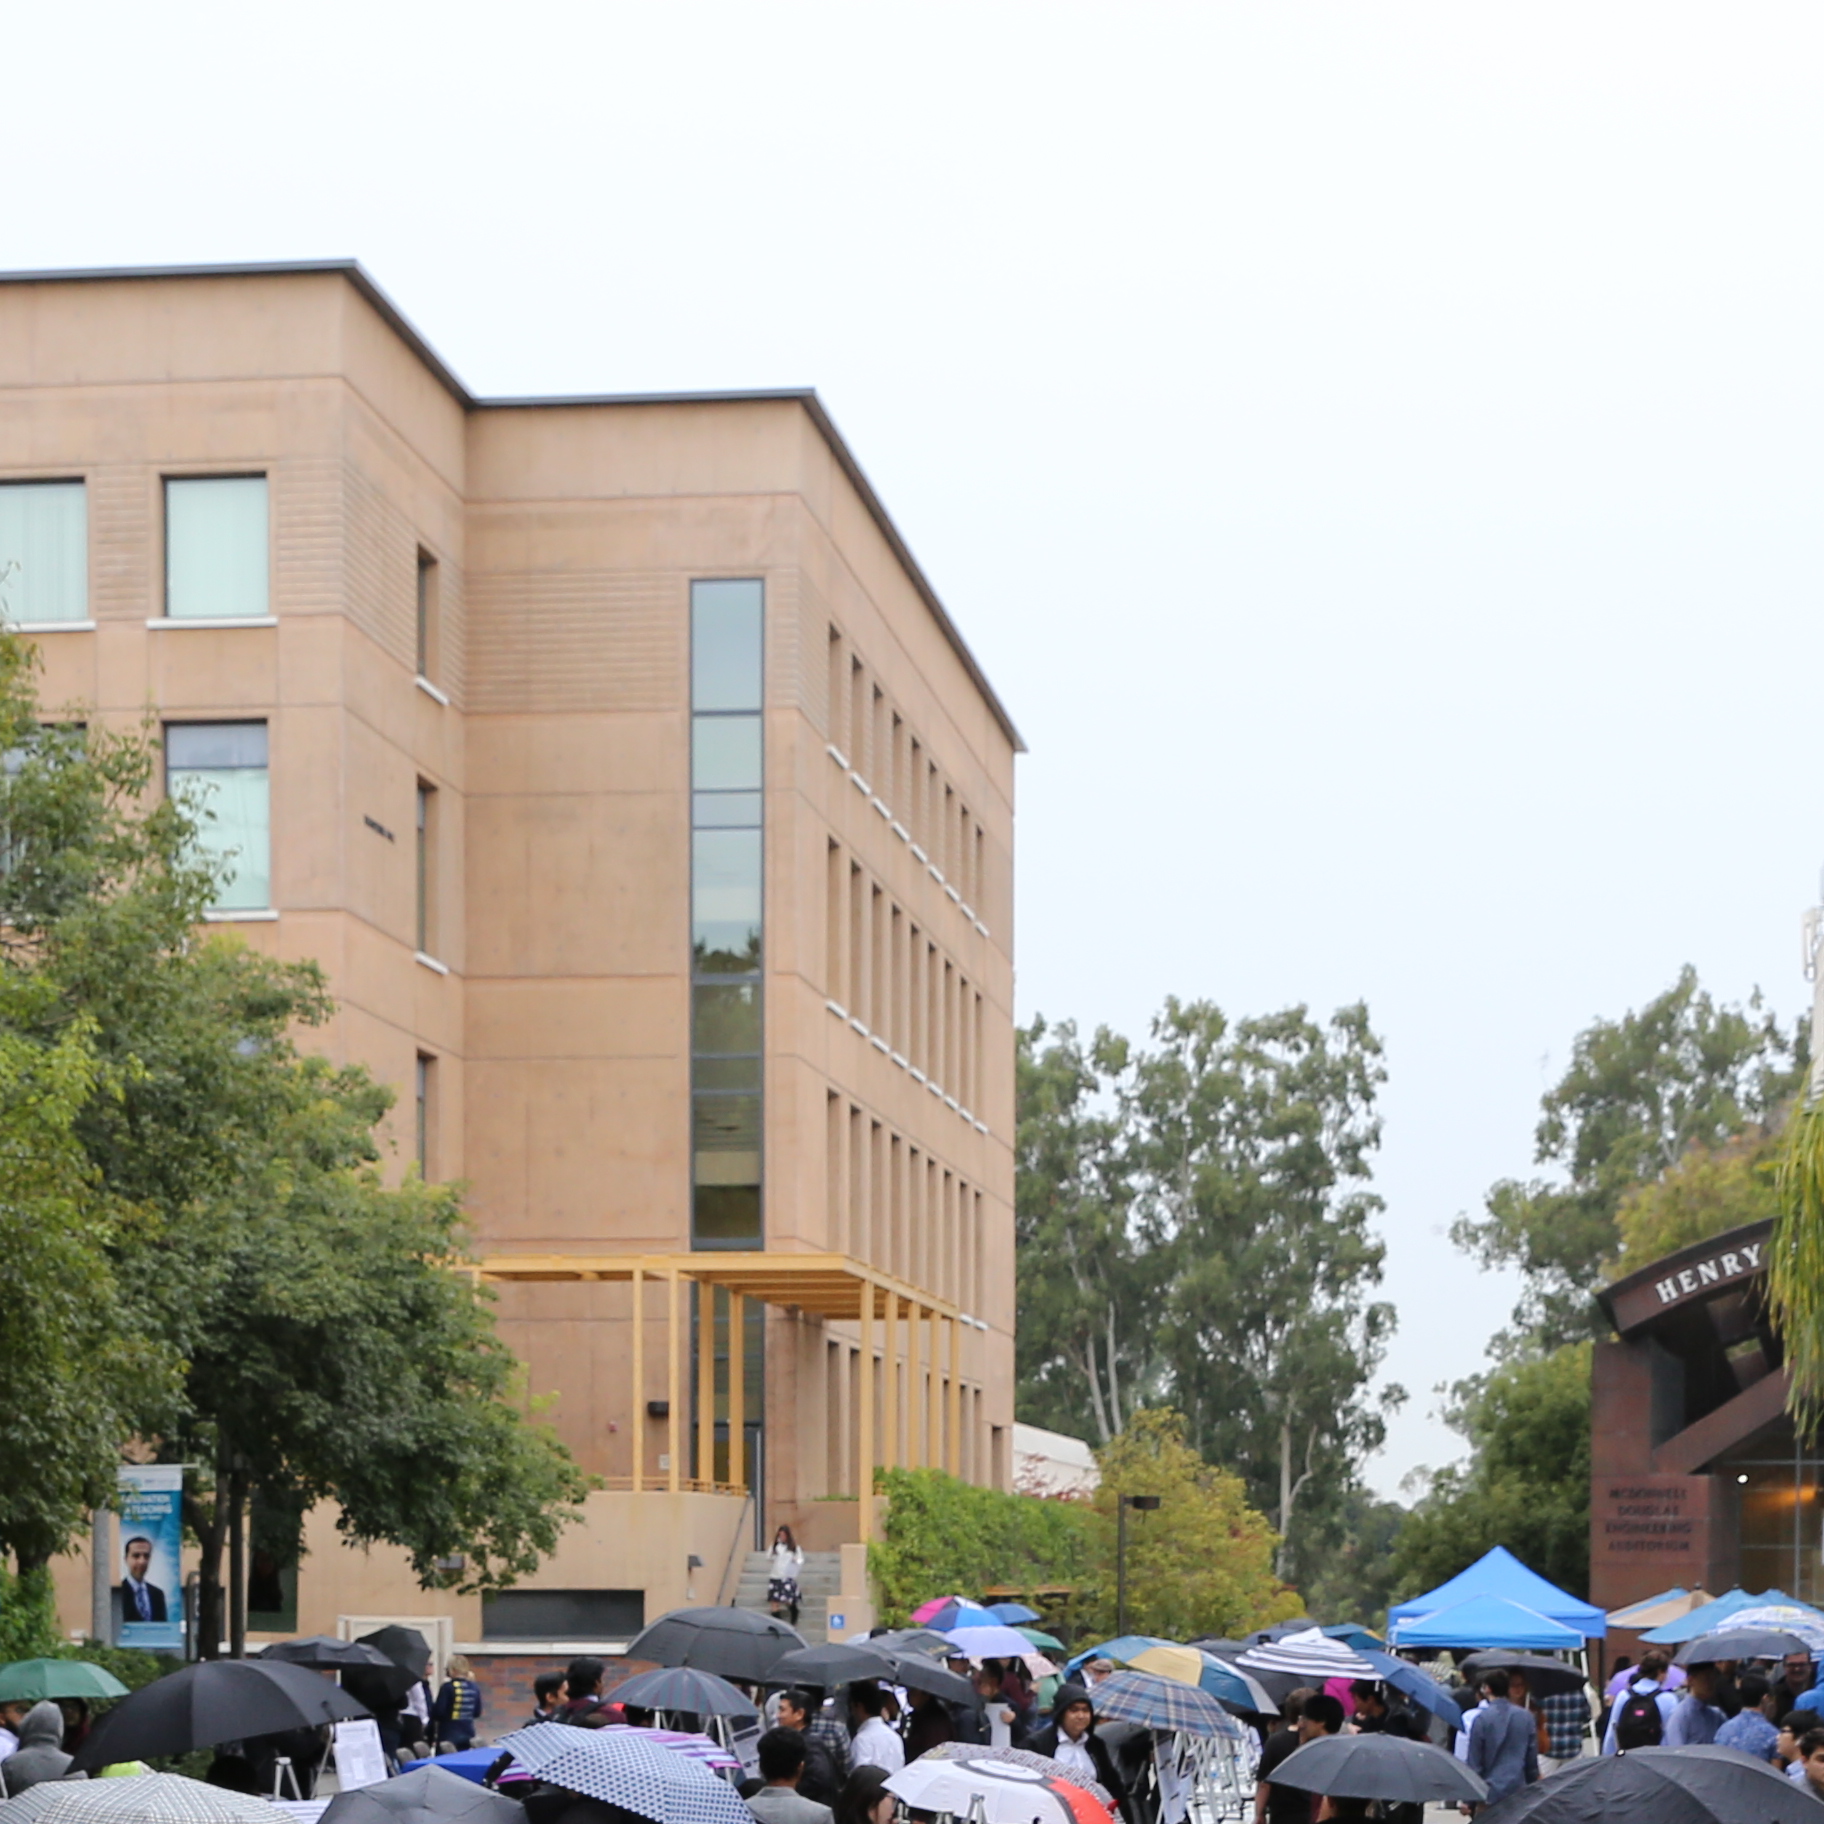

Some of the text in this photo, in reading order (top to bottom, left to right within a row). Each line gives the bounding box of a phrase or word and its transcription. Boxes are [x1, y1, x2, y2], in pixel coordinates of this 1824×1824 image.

[1655, 1243, 1761, 1304] HENRY
[1617, 1505, 1680, 1516] DOUGLAS
[1605, 1521, 1693, 1533] ENGINEERING
[1608, 1540, 1690, 1551] AUDITORIUM
